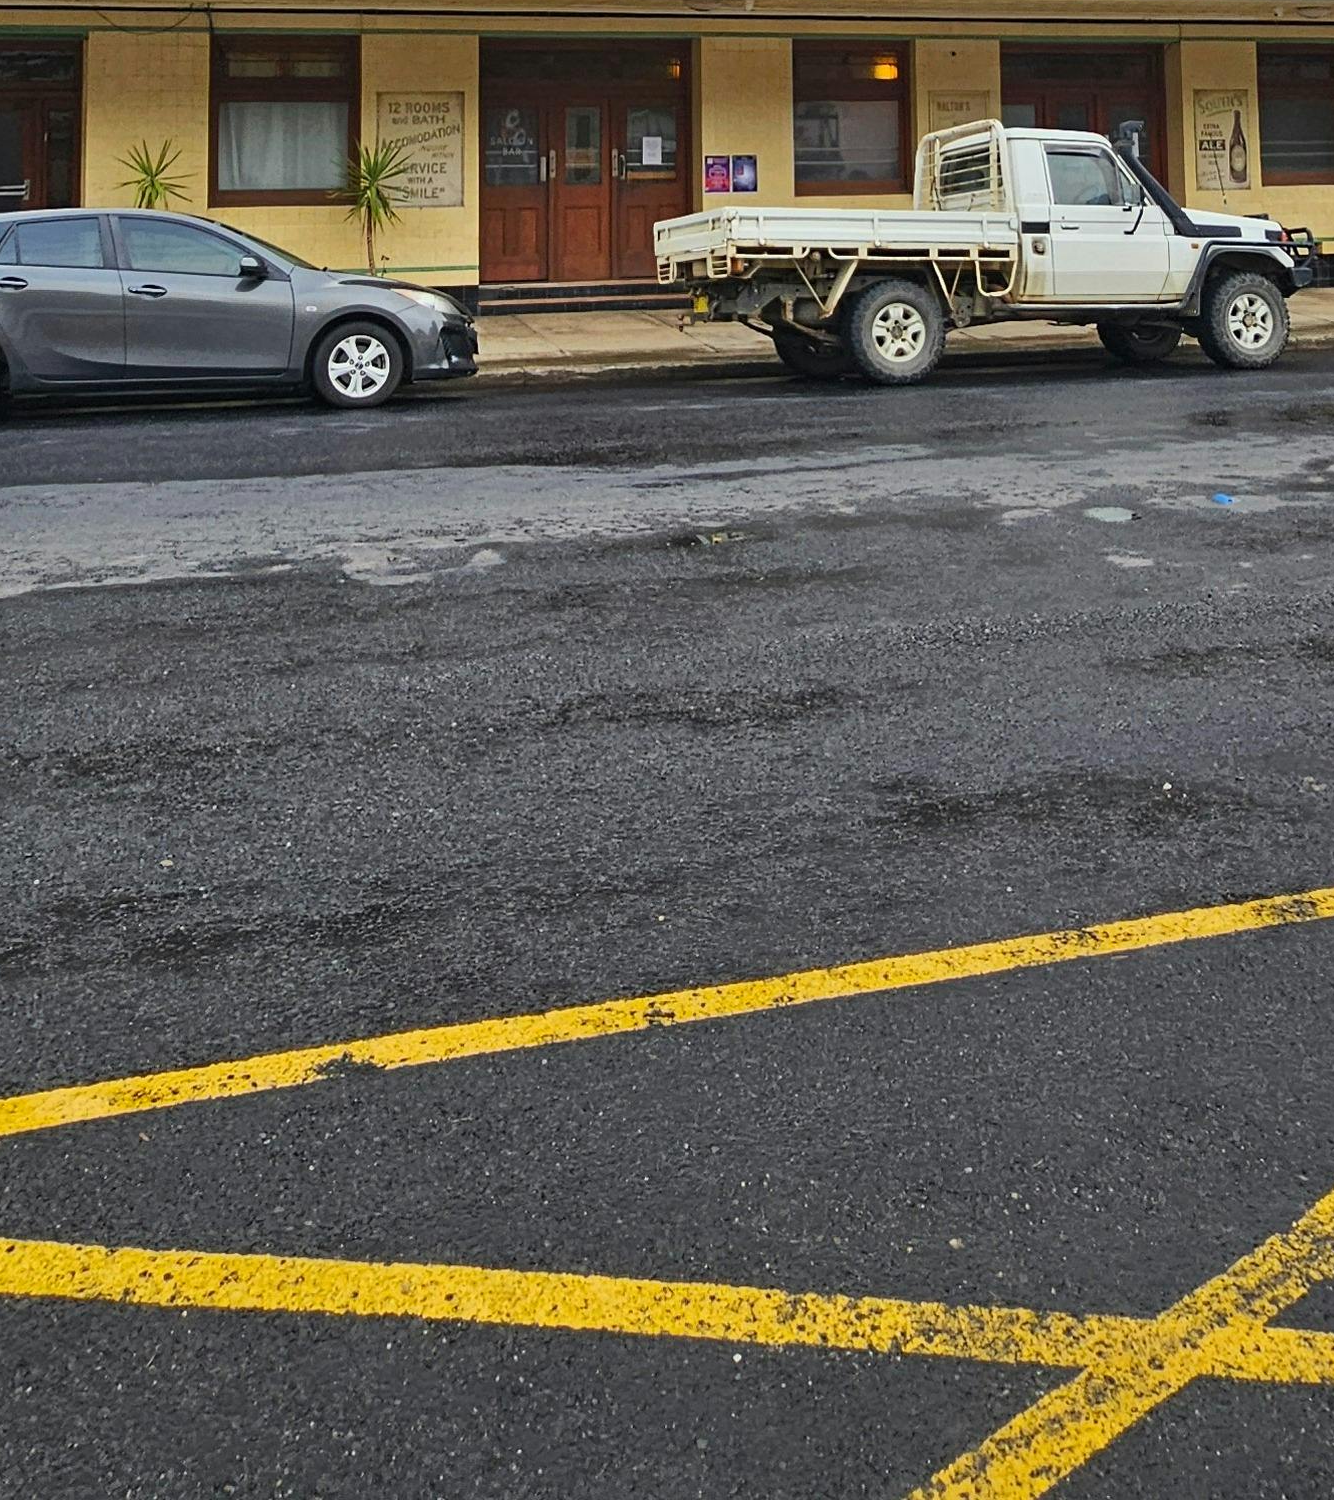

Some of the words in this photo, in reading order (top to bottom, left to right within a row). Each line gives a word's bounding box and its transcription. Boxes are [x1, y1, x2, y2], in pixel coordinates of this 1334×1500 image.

[388, 102, 400, 114] 12
[405, 102, 451, 114] ROOMS
[411, 115, 446, 125] BATH
[1201, 141, 1224, 150] ALE
[502, 147, 524, 157] BAR
[399, 162, 448, 174] ERVICE
[427, 176, 434, 184] A
